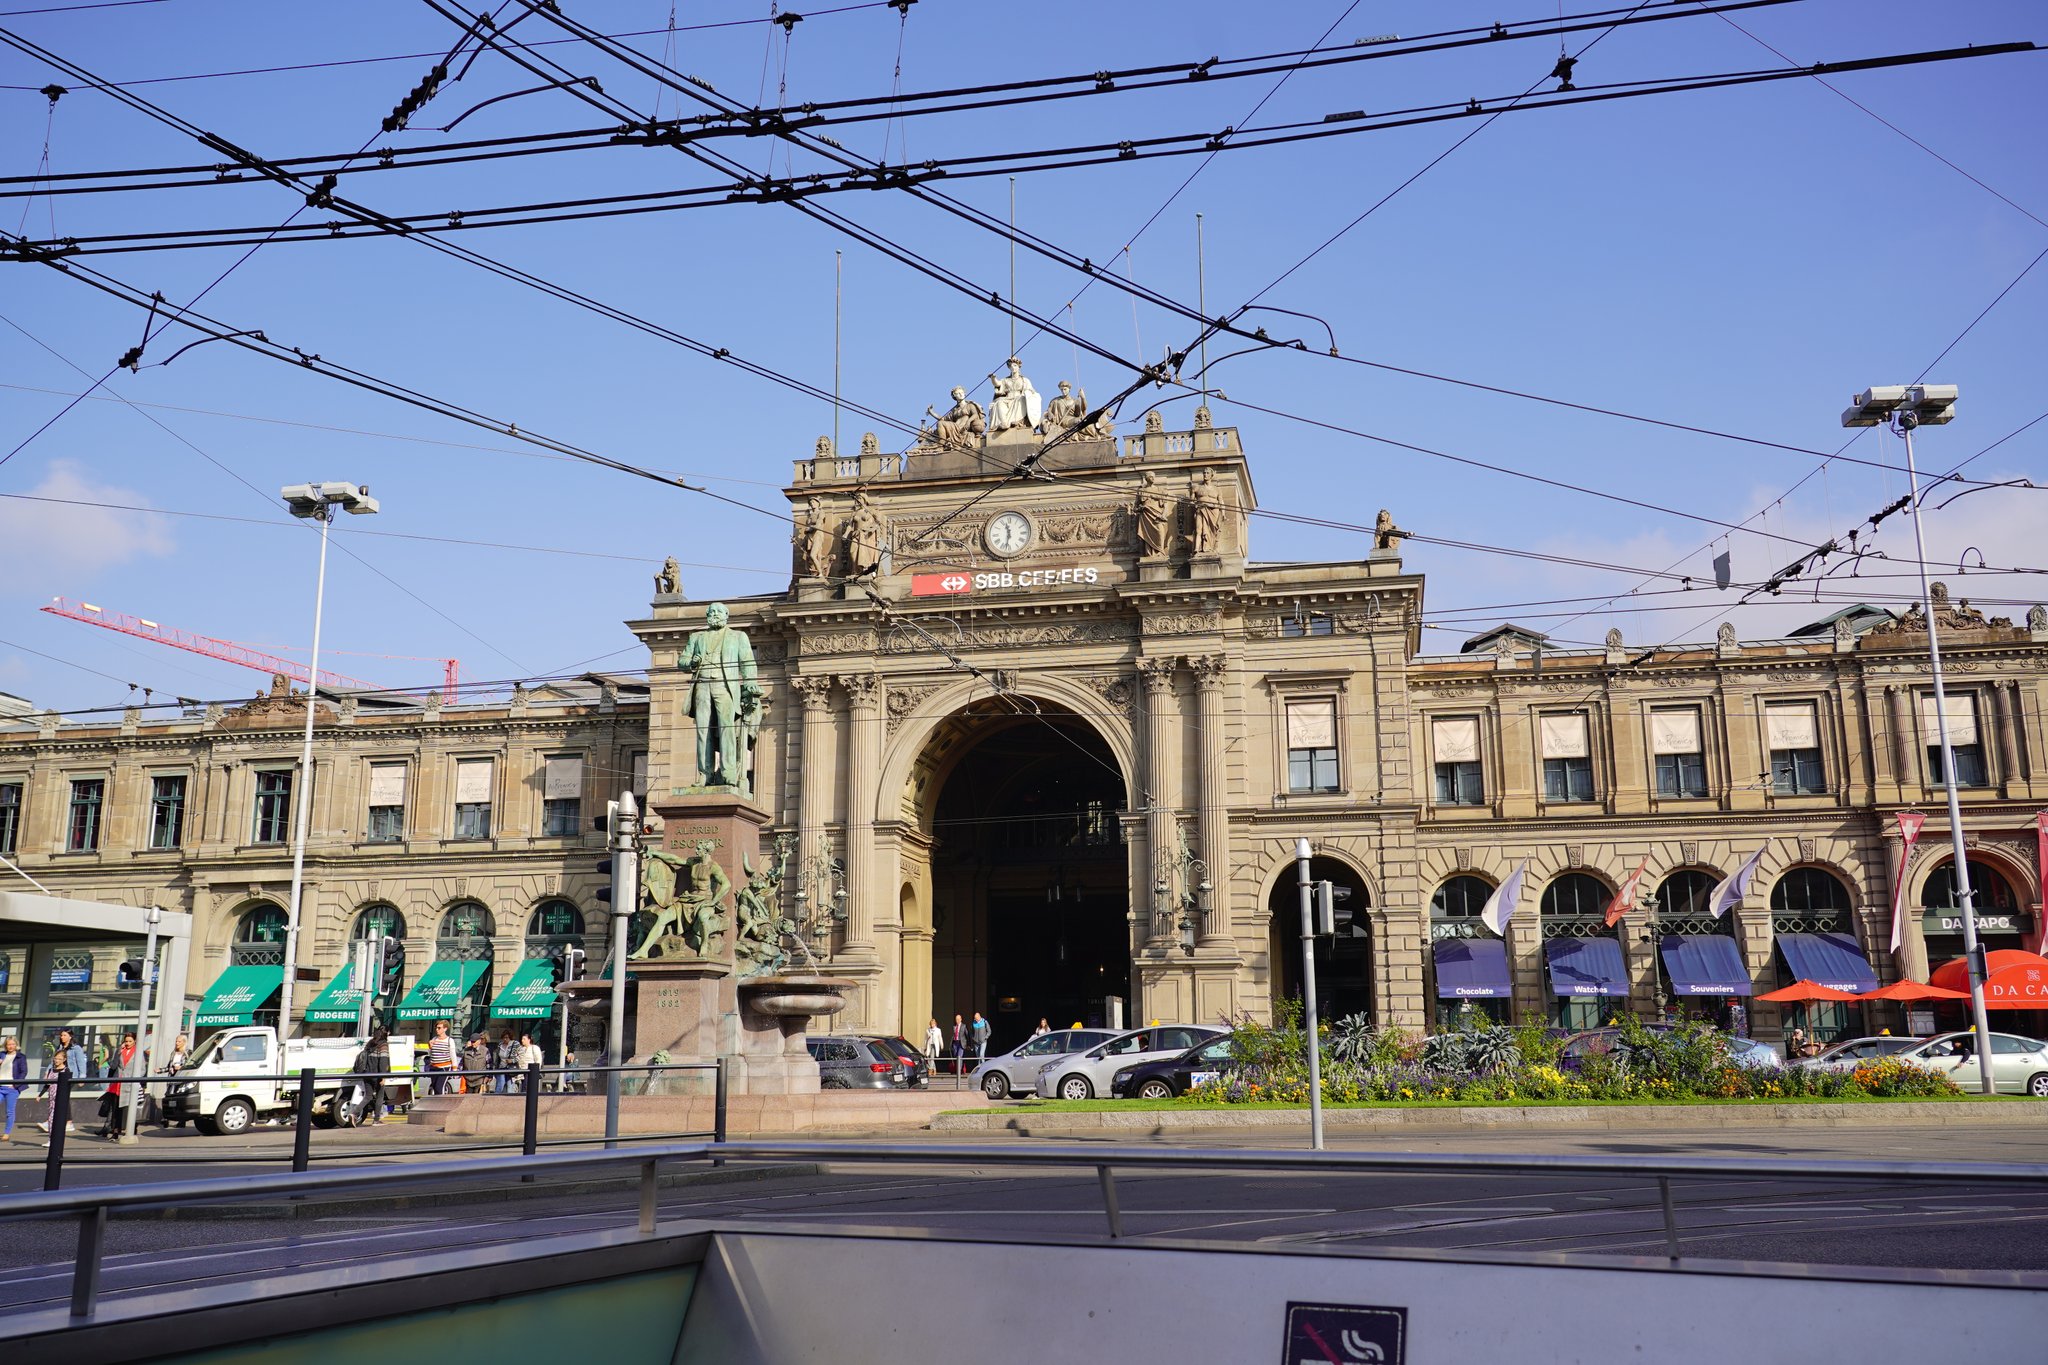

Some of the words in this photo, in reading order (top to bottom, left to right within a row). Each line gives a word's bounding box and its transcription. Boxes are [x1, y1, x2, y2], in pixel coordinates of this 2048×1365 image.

[975, 573, 1014, 589] SBB
[675, 825, 721, 835] ALFRED
[1941, 917, 1964, 929] DA
[1455, 987, 1494, 995] Chocolate
[1574, 985, 1608, 993] Watches
[1690, 985, 1735, 993] Souveniers
[313, 1011, 357, 1020] DROGERIE
[400, 1008, 455, 1018] PARFUMERIE
[497, 1007, 545, 1016] PHARMACY
[196, 1015, 240, 1024] APOTHEKE
